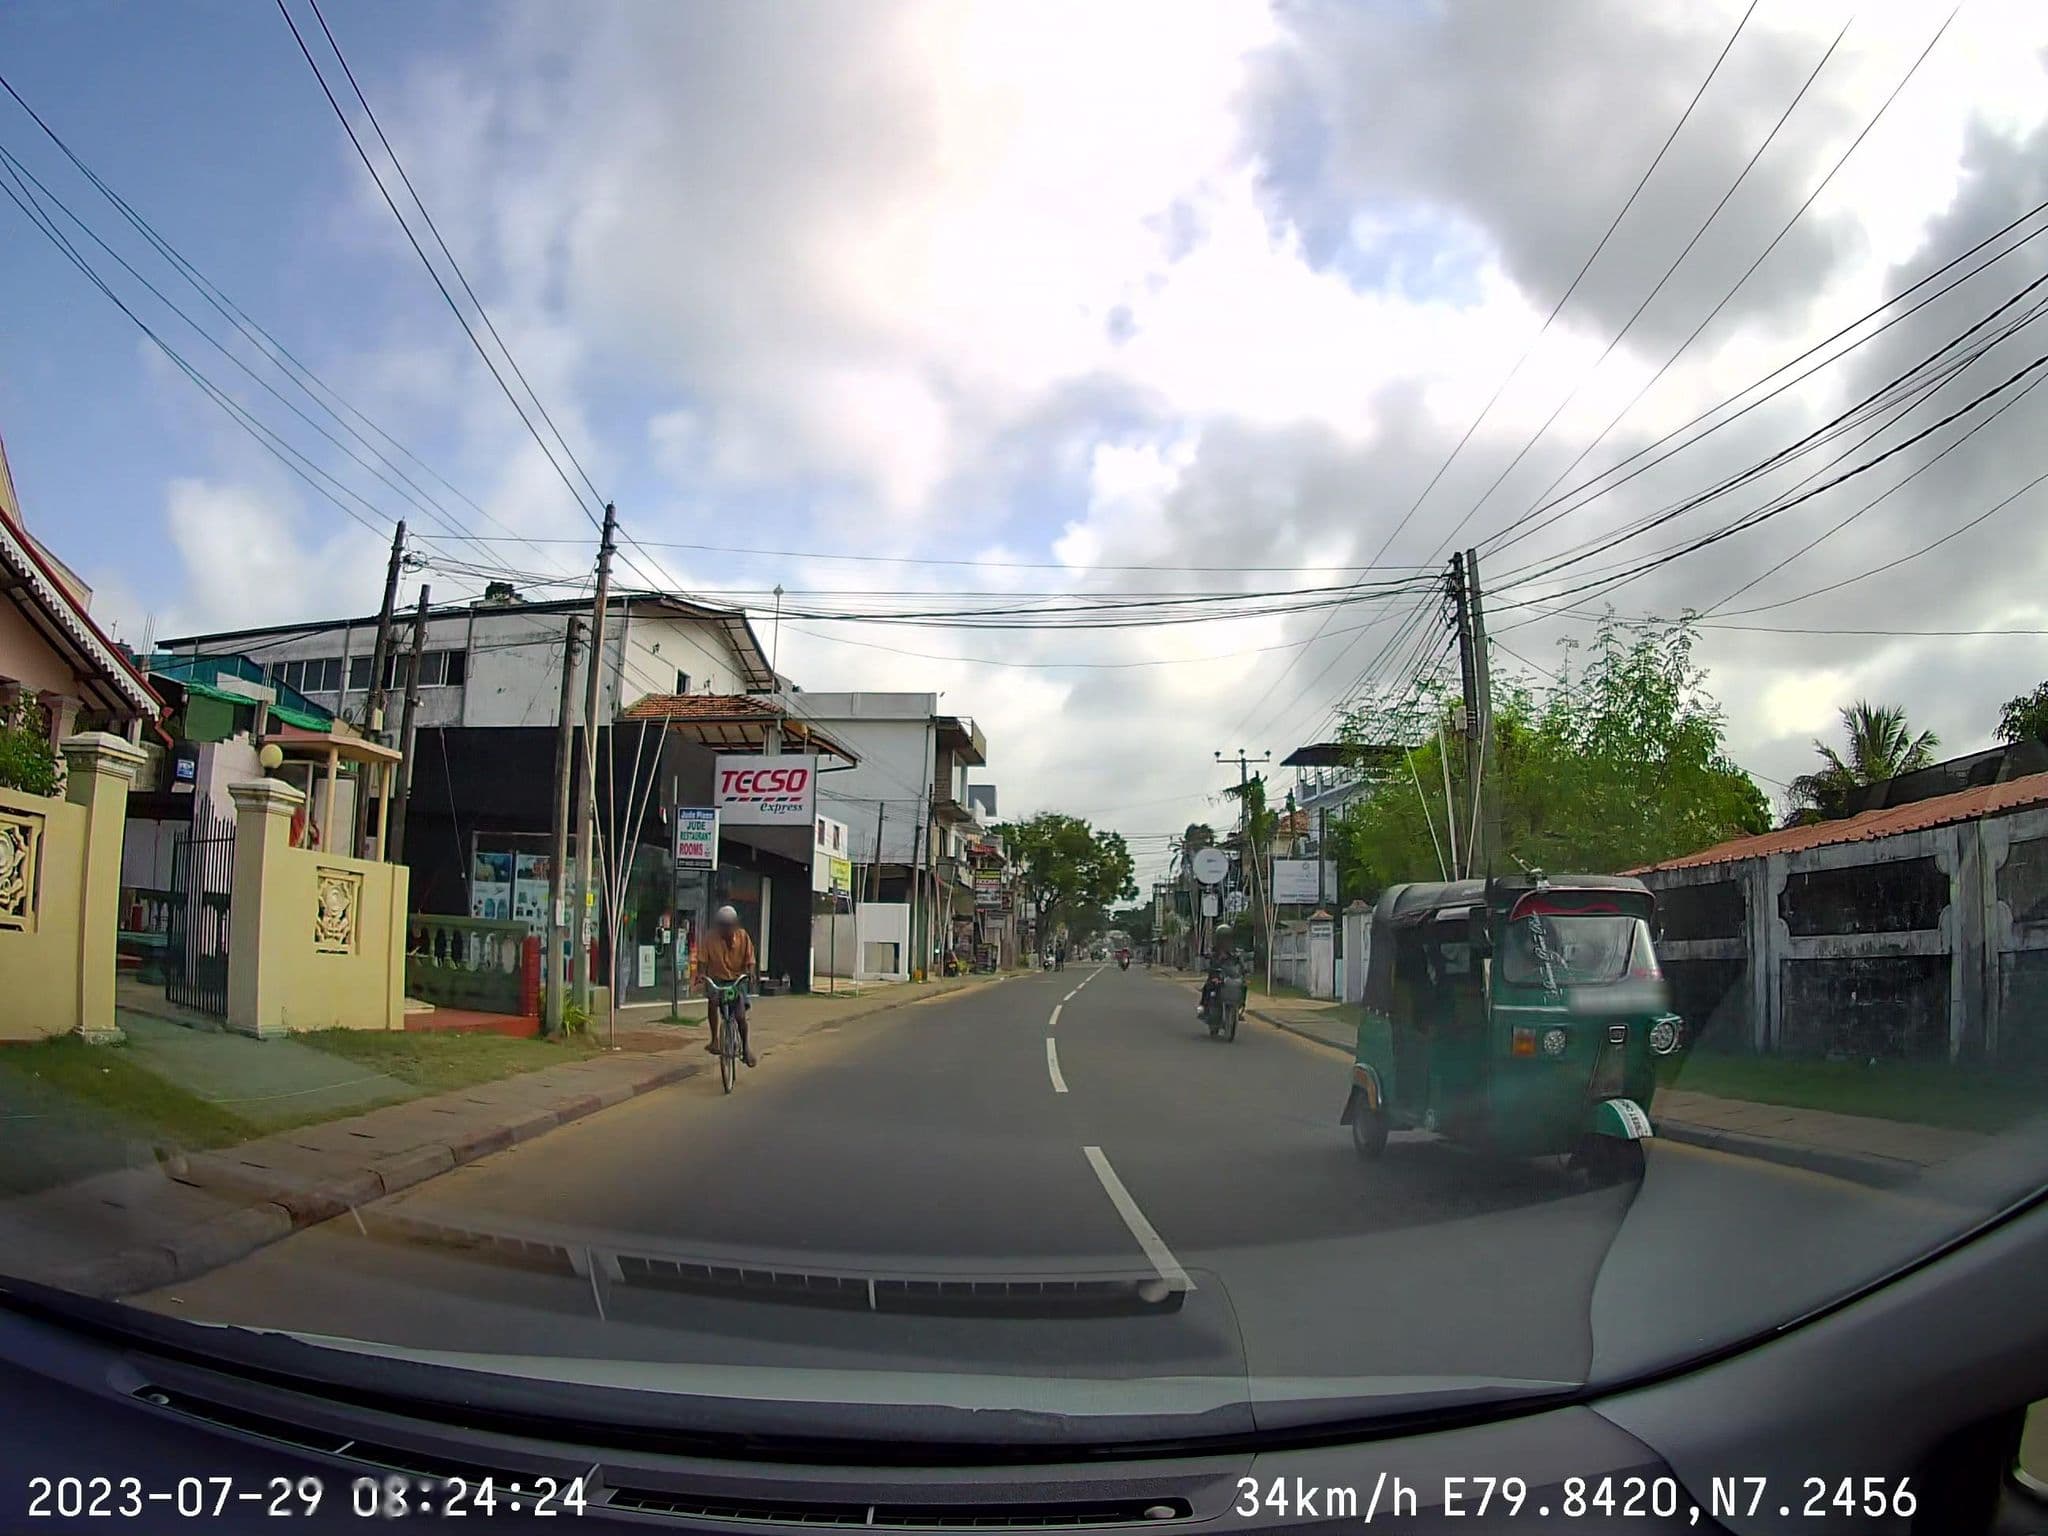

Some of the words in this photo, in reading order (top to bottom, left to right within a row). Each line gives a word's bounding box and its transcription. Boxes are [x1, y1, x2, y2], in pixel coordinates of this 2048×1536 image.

[721, 769, 808, 793] TECSO
[760, 802, 803, 814] express
[686, 821, 706, 830] JUDE
[680, 832, 712, 841] RESTAURANT
[679, 843, 703, 856] ROOMS
